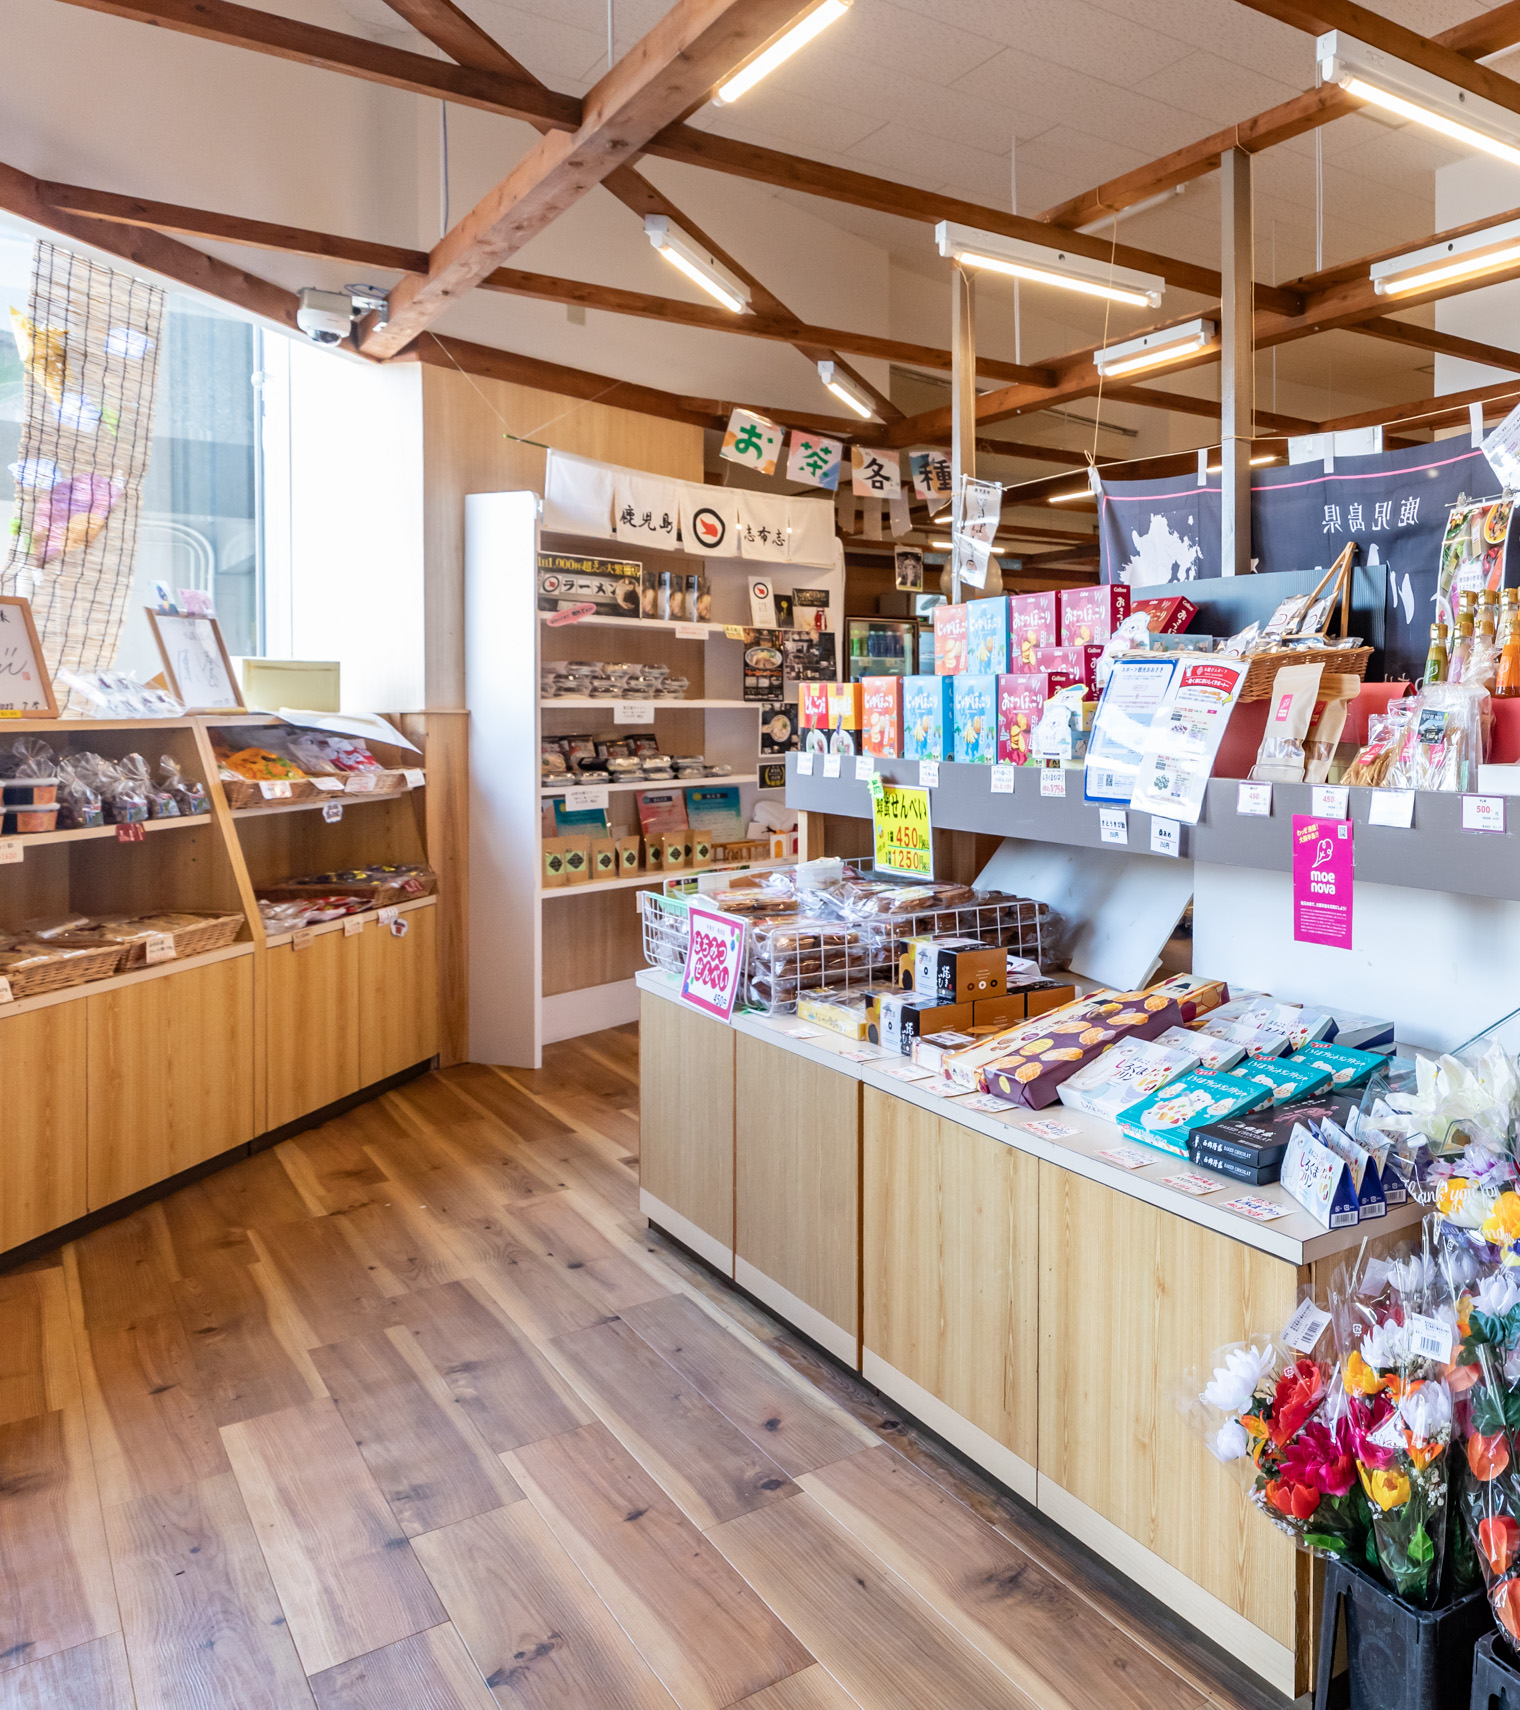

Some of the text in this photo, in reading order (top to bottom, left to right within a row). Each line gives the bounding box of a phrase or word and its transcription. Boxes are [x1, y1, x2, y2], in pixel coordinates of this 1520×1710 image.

[620, 505, 786, 548] 鹿児島 志布志
[1310, 870, 1335, 883] moe
[1310, 883, 1336, 895] nova
[693, 930, 727, 965] はちみつ
[694, 956, 730, 992] せんべい
